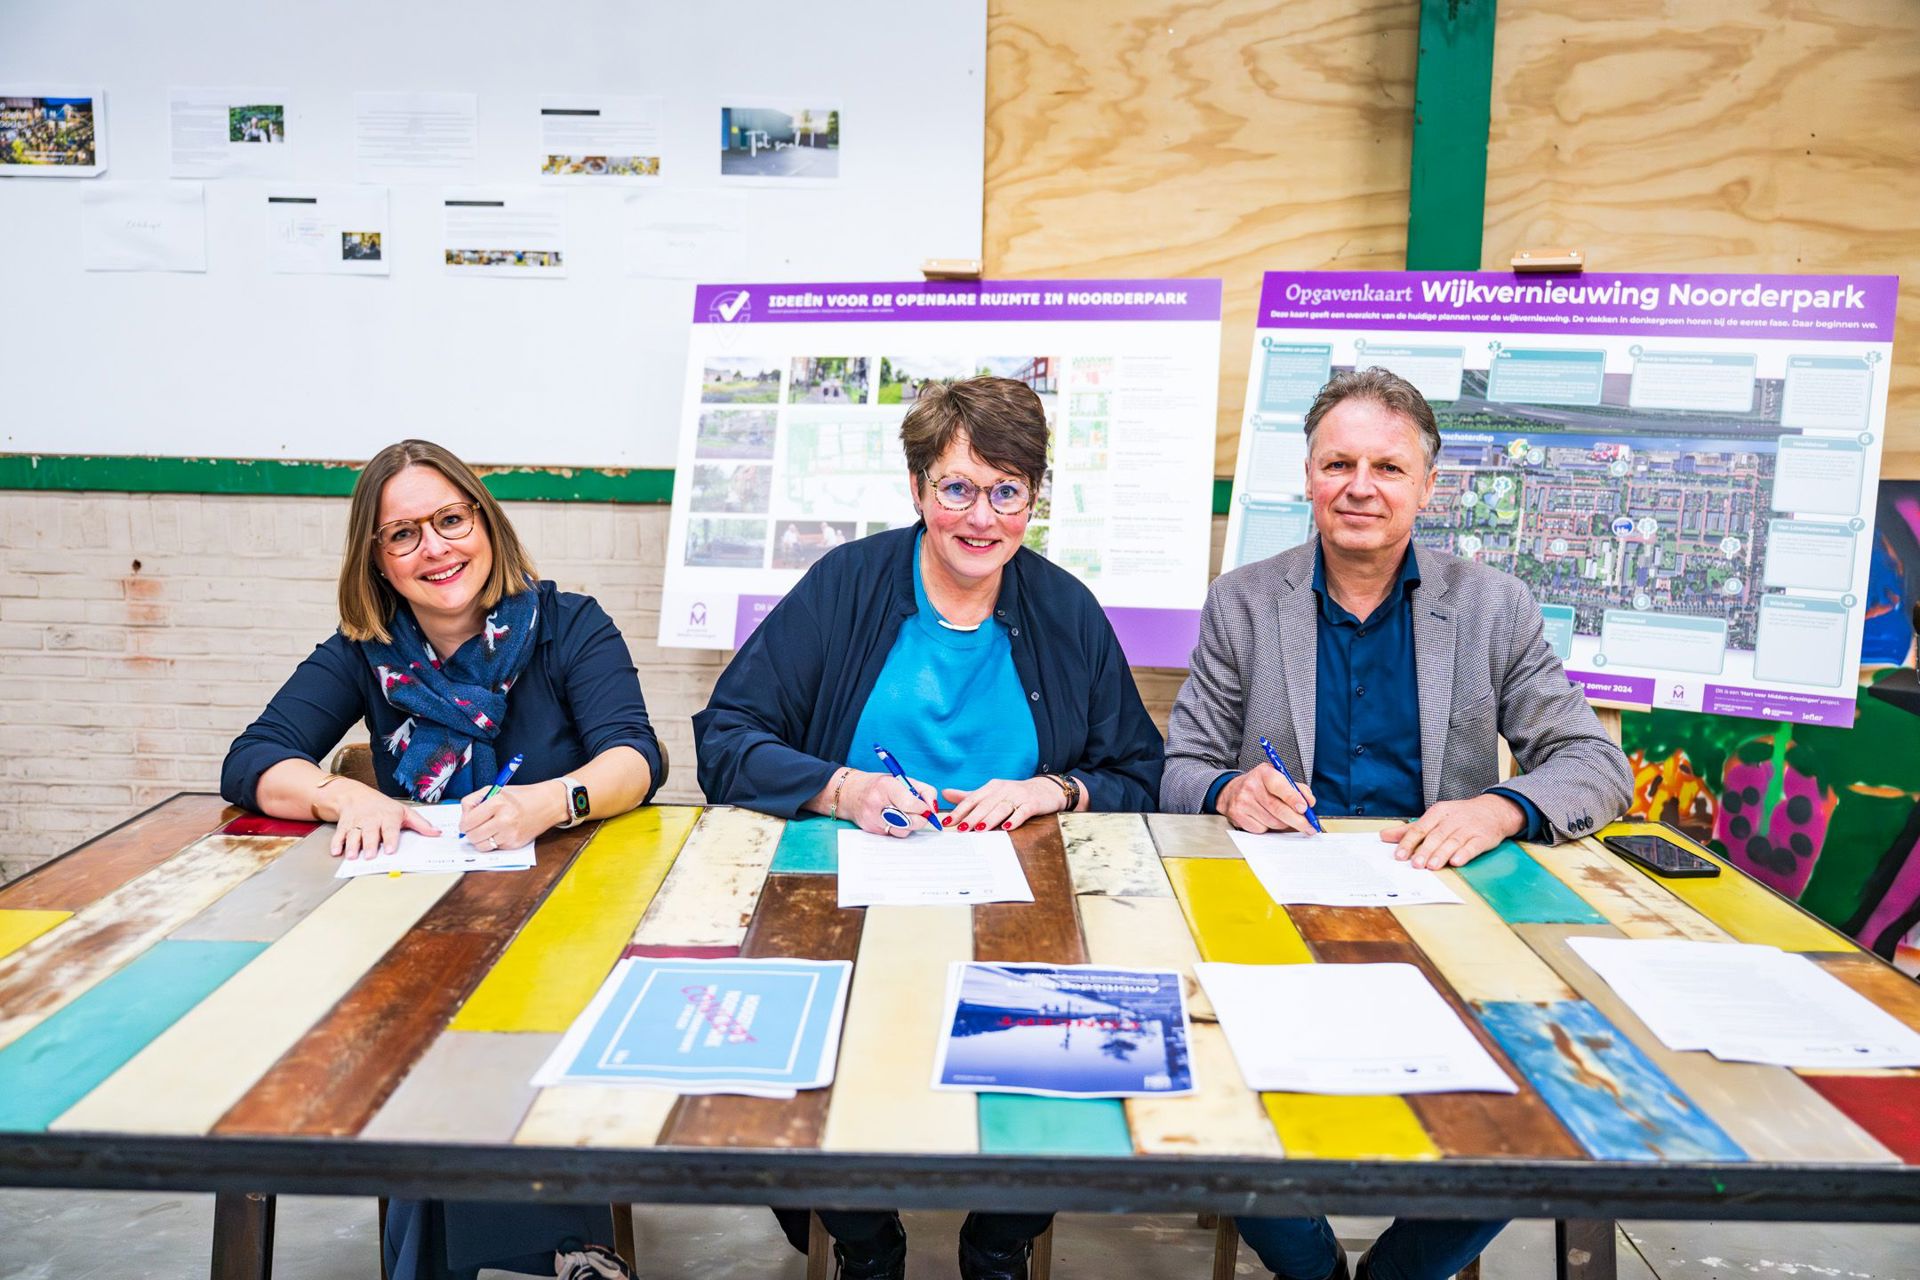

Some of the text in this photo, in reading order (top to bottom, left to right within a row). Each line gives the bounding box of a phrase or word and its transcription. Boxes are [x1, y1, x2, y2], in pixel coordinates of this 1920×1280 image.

[768, 291, 1188, 307] IDEEËN VOOR DE OPENBARE RUIMTE IN NOORDERPARK
[1285, 279, 1865, 313] Opgavenkaart Wijkvernieuwing Noorderpark
[1270, 310, 1289, 318] Deze
[1290, 310, 1309, 318] kaart
[1310, 311, 1329, 320] geeft
[1346, 311, 1380, 319] overzicht
[1408, 312, 1437, 322] huidige
[1438, 313, 1470, 322] plannen
[1490, 313, 1501, 321] de
[1503, 313, 1570, 324] wijkvernieuwing.
[1572, 315, 1584, 323] De
[1586, 315, 1617, 323] vlakken
[1620, 316, 1628, 324] in
[1629, 316, 1684, 325] donkergroen
[1687, 317, 1712, 325] horen
[1714, 318, 1725, 327] bij
[1727, 318, 1738, 326] de
[1769, 318, 1790, 327] fase.
[1792, 319, 1814, 327] Daar
[1815, 319, 1859, 329] beginnen
[1587, 682, 1612, 691] zomer
[1613, 684, 1632, 693] 2024
